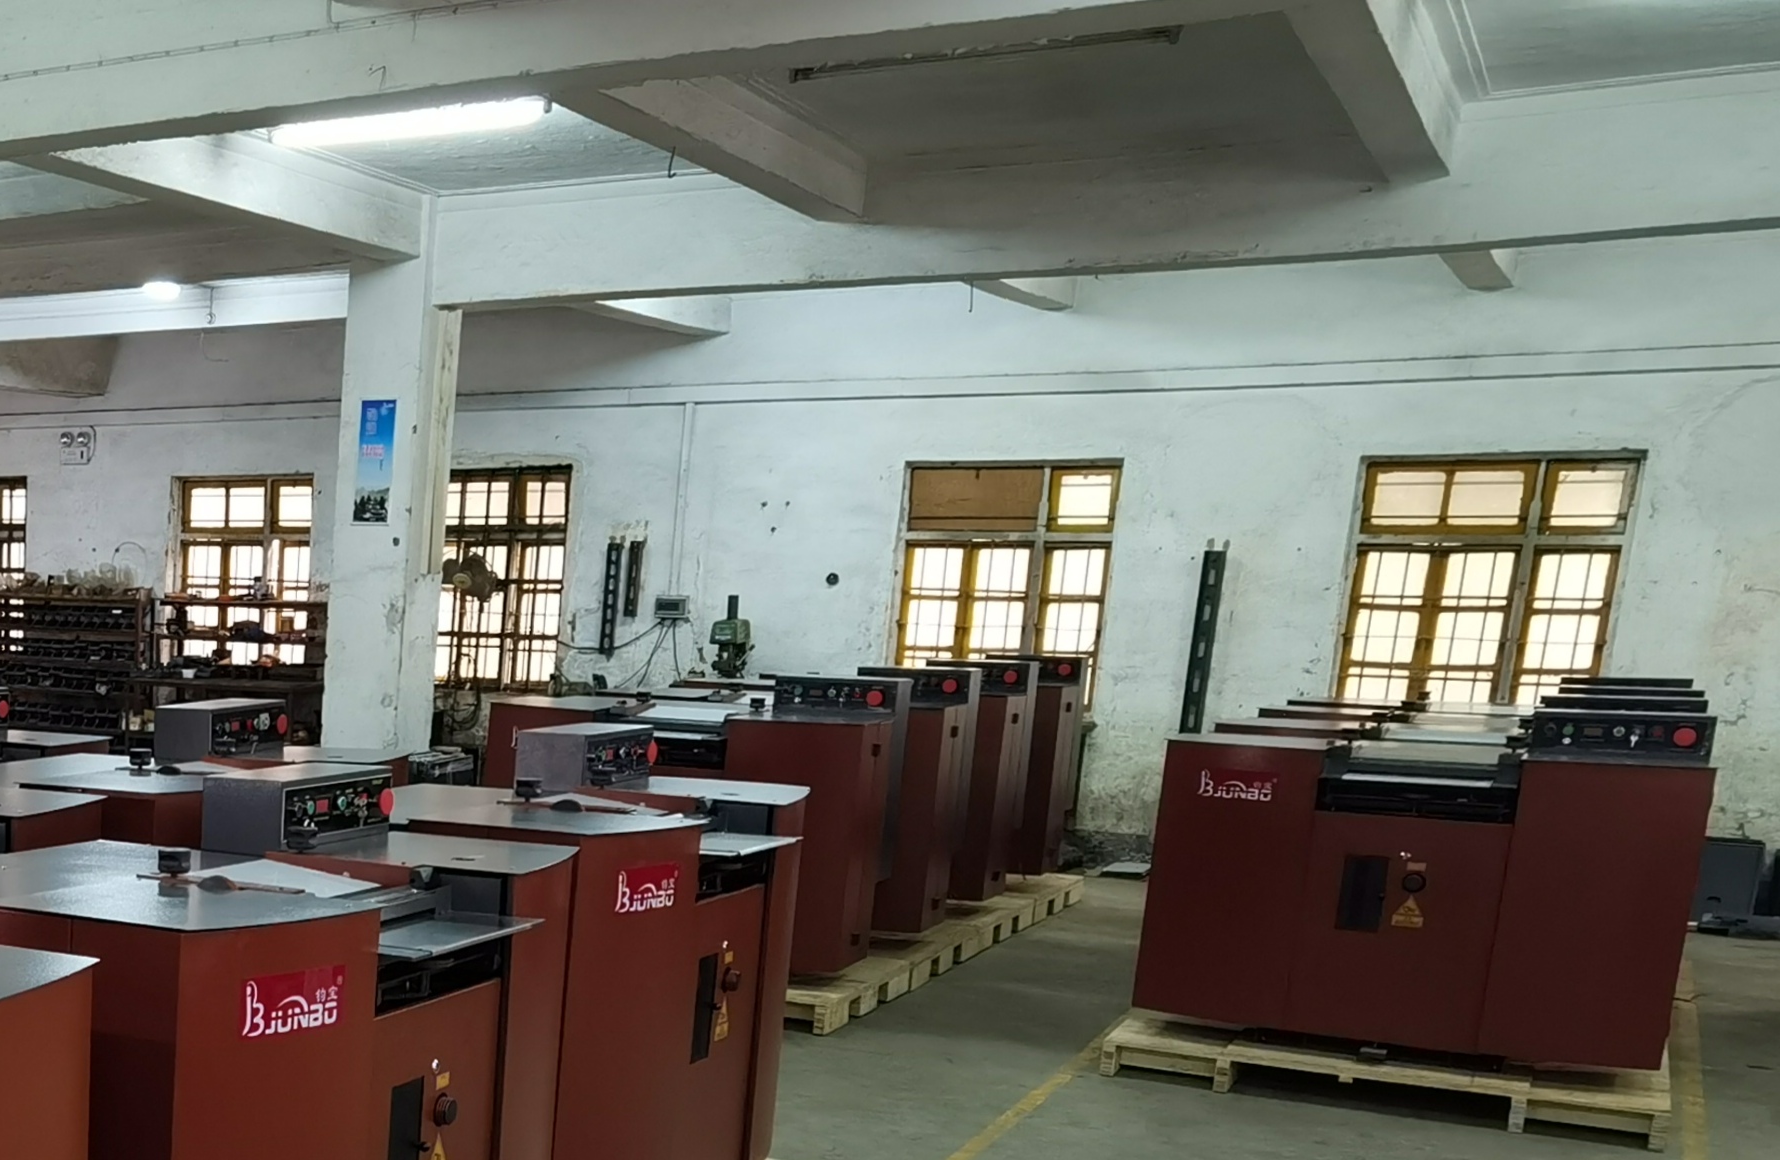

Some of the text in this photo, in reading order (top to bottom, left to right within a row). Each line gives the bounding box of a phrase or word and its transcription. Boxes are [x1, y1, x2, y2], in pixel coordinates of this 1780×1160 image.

[1213, 784, 1272, 801] JUNBO
[629, 888, 675, 912] JUNBO
[265, 1000, 338, 1035] JUNBO
